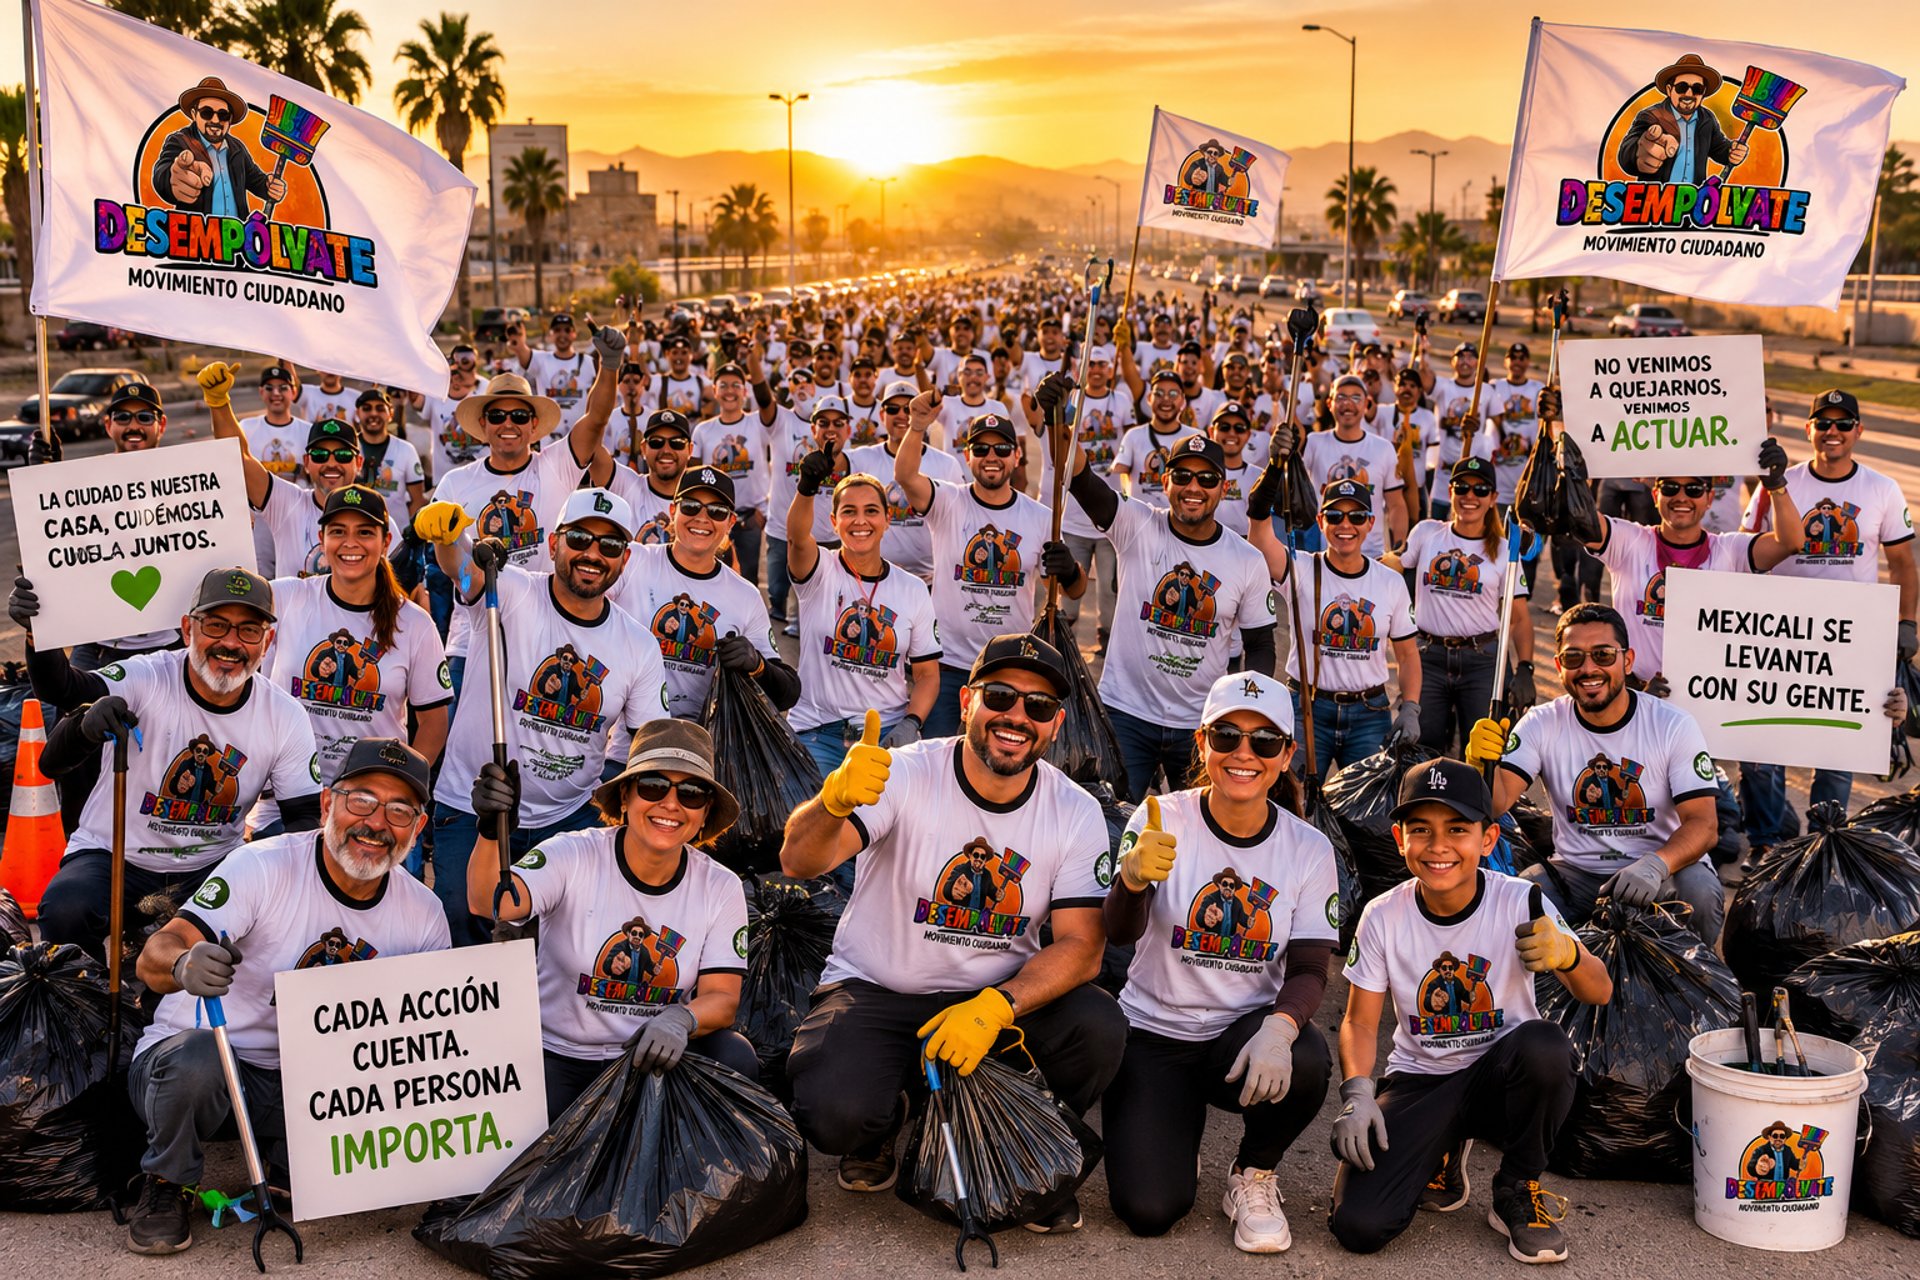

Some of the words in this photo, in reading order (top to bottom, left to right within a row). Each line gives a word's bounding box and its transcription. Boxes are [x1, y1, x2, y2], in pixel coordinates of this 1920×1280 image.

[1556, 176, 1811, 235] DESEMPÓLVATE
[94, 198, 378, 288] DESEMPÓLVATE
[1583, 236, 1676, 254] MOVIMIENTO
[1681, 239, 1765, 258] CIUDADANO
[128, 267, 237, 298] MOVIMIENTO
[244, 283, 345, 313] CIUDADANO
[1595, 358, 1620, 375] NO
[1627, 355, 1712, 374] VENIMOS
[1590, 382, 1602, 399] A
[1609, 378, 1727, 399] QUEJARNOS,
[1624, 401, 1690, 415] VENIMOS
[1591, 423, 1605, 442] A
[1611, 415, 1738, 452] ACTUAR.
[39, 492, 60, 511] LA
[65, 484, 123, 508] CIUDAD
[127, 482, 146, 500] ES
[151, 472, 220, 498] NUESTRA
[44, 514, 110, 539] CASA,
[130, 530, 216, 558] JUNTOS.
[1697, 608, 1813, 640] MEXICALI
[1823, 618, 1853, 643] SE
[1725, 644, 1833, 676] LEVANTA
[1688, 675, 1737, 701] CON
[1746, 679, 1777, 705] SU
[1786, 683, 1871, 714] GENTE.
[314, 997, 388, 1034] CADA
[399, 975, 500, 1023] ACCIÓN
[353, 1029, 469, 1071] CUENTA.
[309, 1084, 385, 1121] CADA
[394, 1063, 521, 1110] PERSONA
[330, 1111, 513, 1176] IMPORTA.
